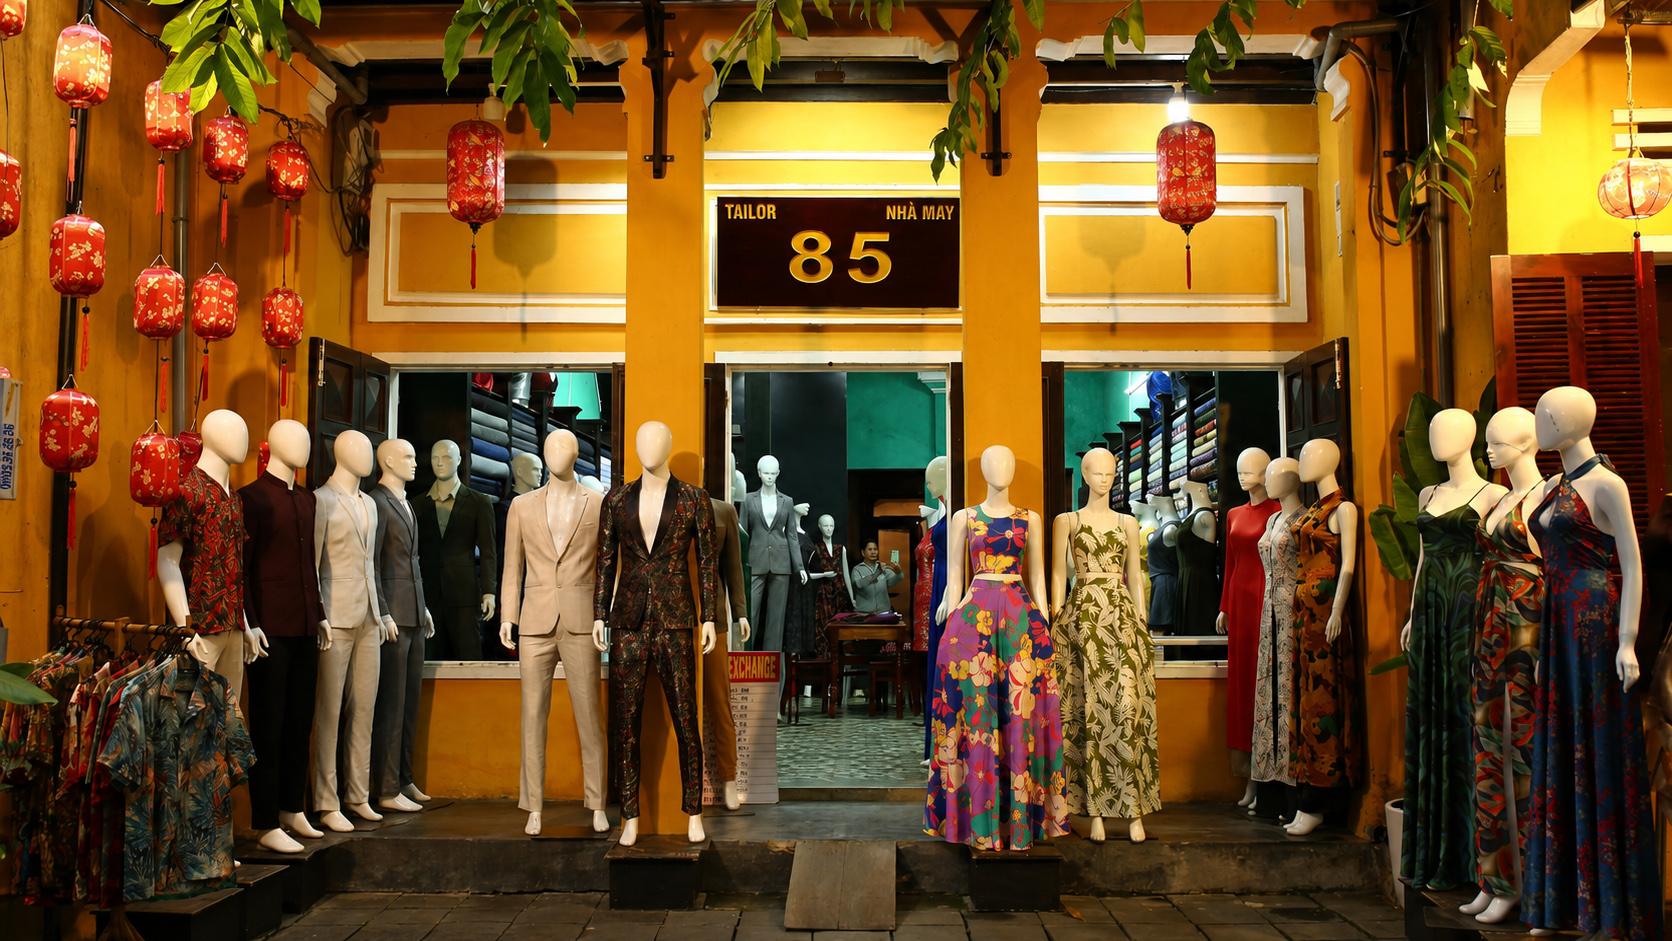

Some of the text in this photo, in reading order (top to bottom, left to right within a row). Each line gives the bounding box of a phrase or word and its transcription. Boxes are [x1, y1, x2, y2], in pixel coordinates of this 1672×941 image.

[725, 203, 777, 220] TAILOR
[886, 202, 955, 220] NHÀ MAY
[789, 230, 892, 284] 85
[728, 655, 777, 679] EXCHANGE
